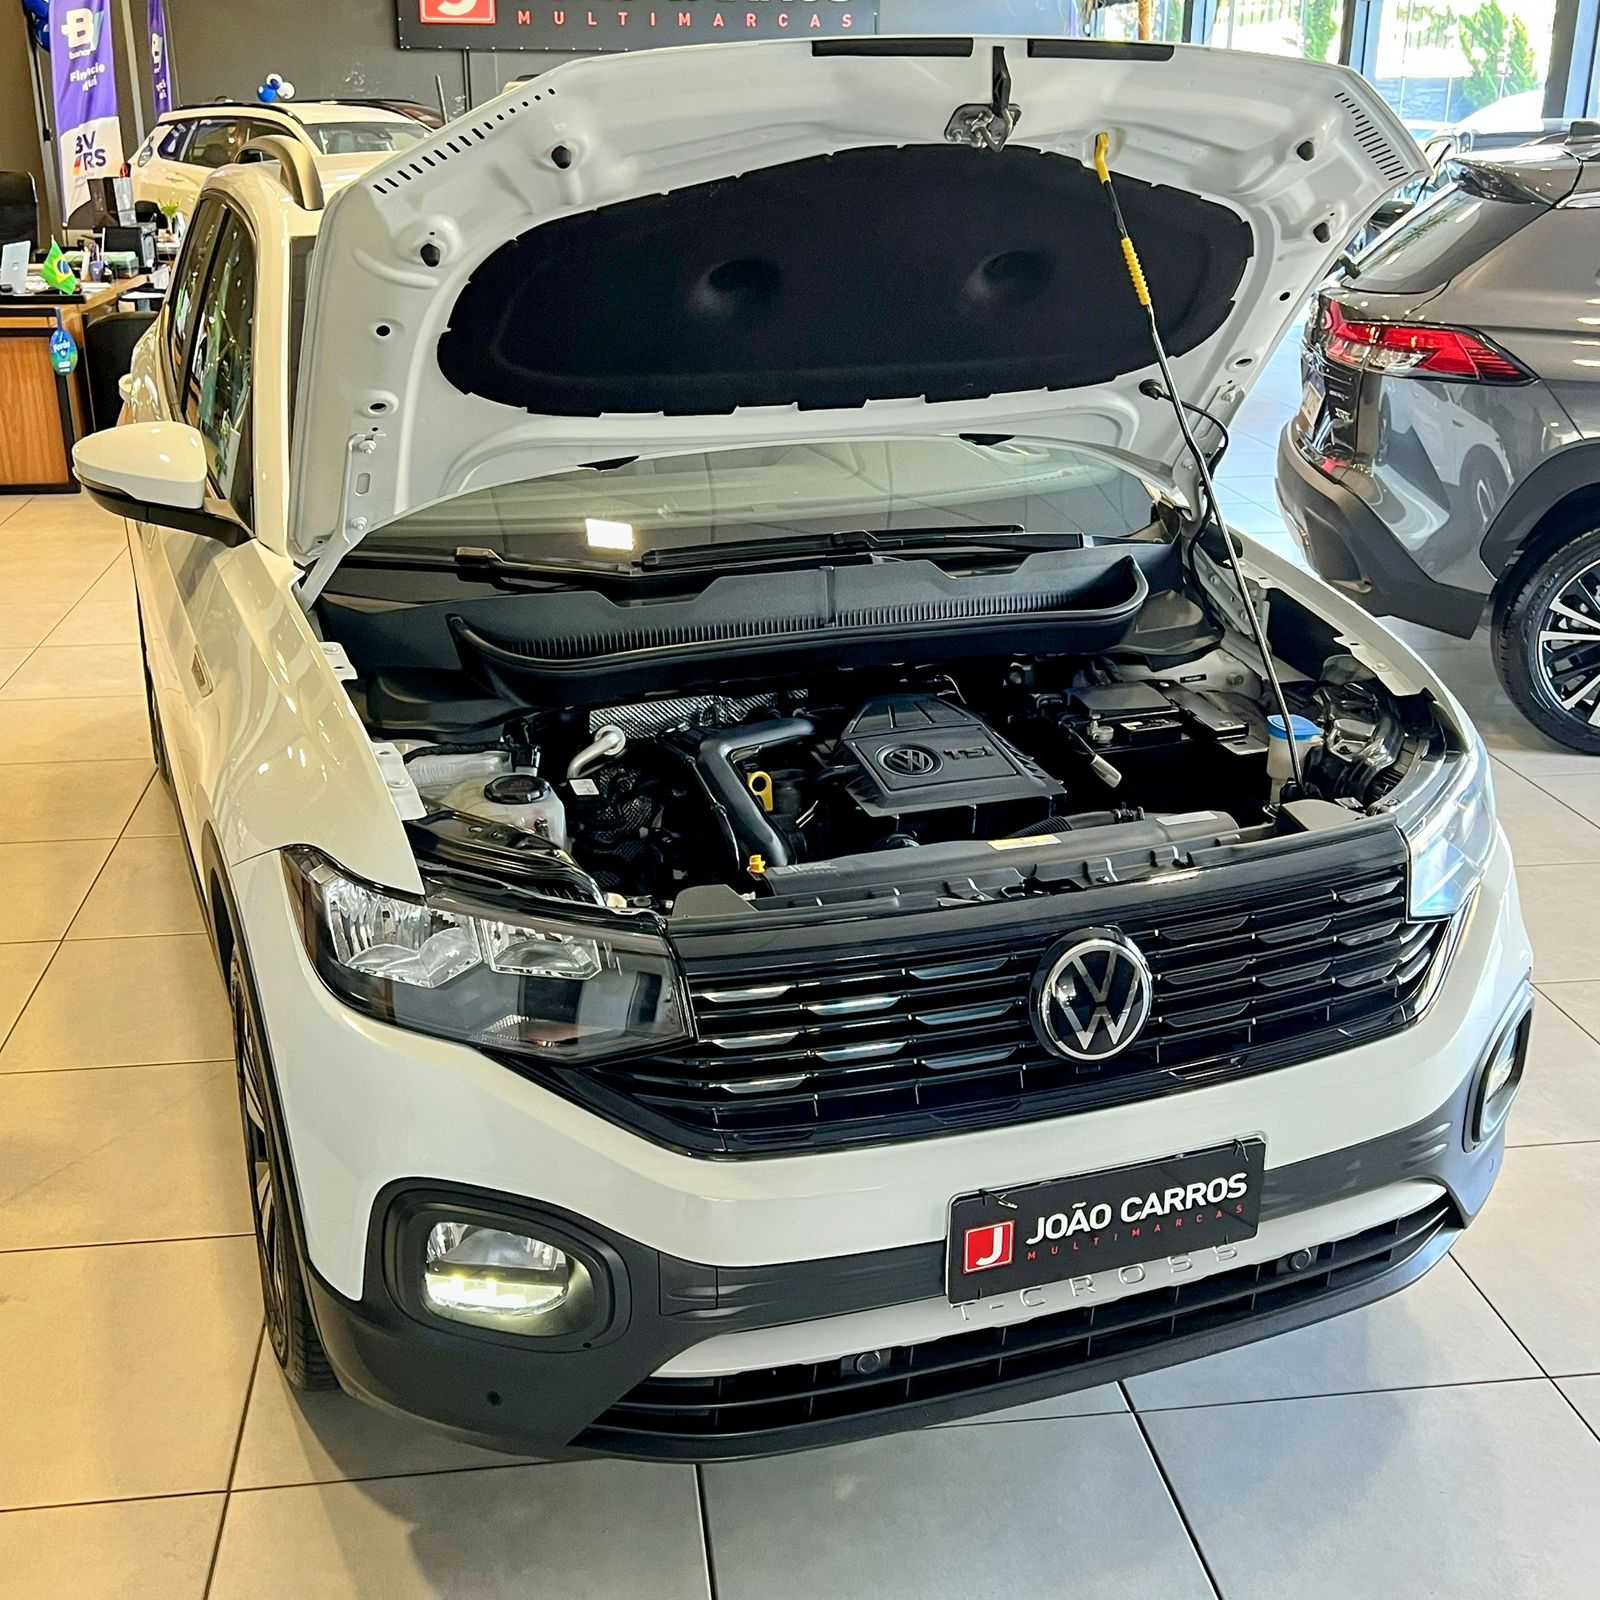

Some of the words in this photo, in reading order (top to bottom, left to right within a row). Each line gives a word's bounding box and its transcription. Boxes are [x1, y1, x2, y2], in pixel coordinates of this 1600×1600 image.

[517, 11, 853, 28] MULTIMARCAS
[1025, 1201, 1112, 1245] JOÃO
[1120, 1172, 1248, 1223] CARROS
[1027, 1204, 1244, 1261] MULTIMARCAS
[975, 1226, 1004, 1267] J
[950, 1245, 1237, 1321] T-CROSS
